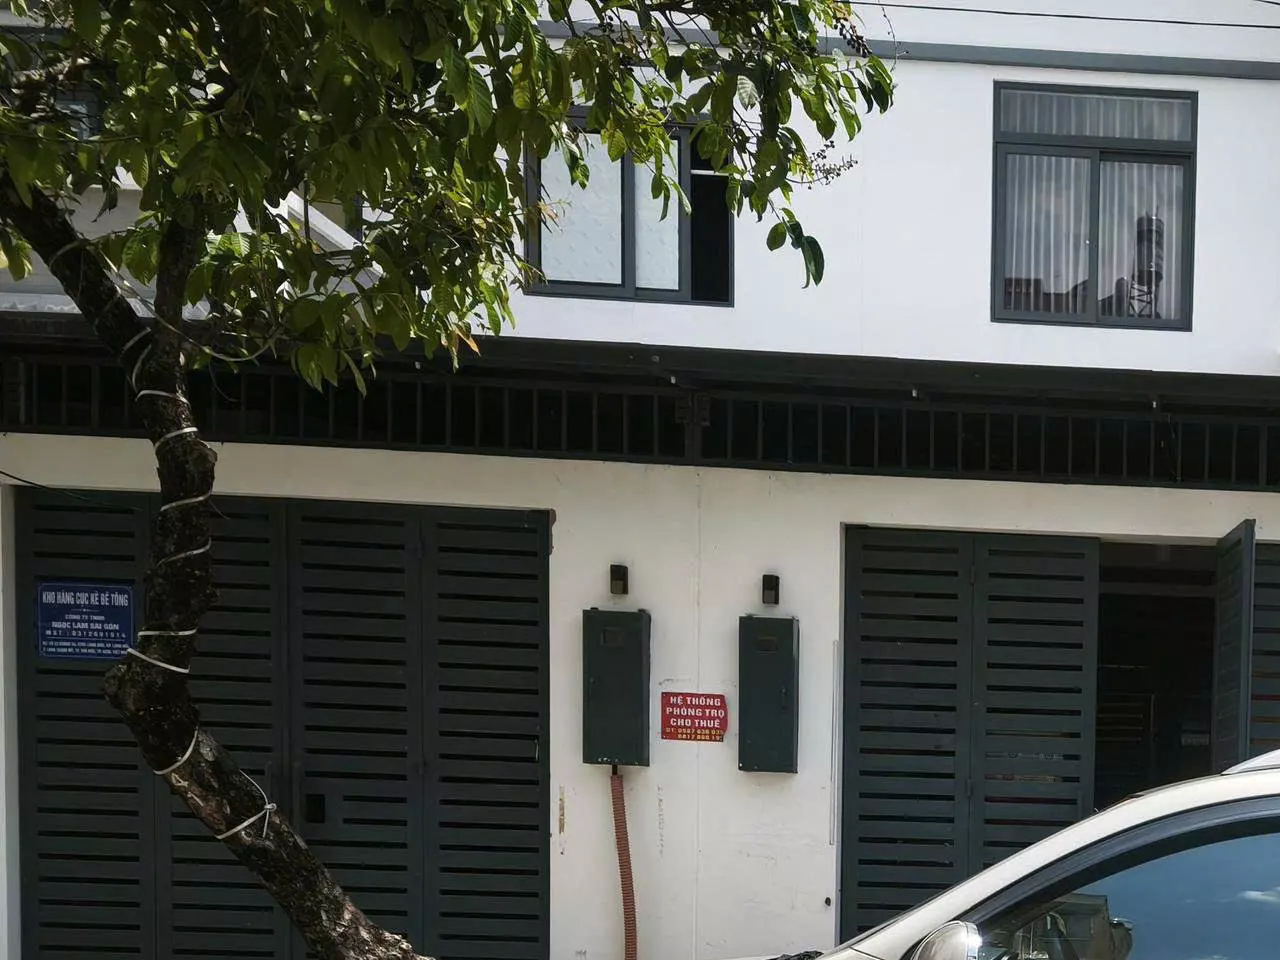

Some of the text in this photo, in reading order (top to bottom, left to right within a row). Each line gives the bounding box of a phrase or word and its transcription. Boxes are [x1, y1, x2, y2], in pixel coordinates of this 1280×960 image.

[42, 591, 55, 604] KHO
[670, 695, 721, 706] HỆ THỐNG
[665, 706, 725, 719] PHÒNG TRỌ
[670, 718, 721, 728] CHO THUÊ
